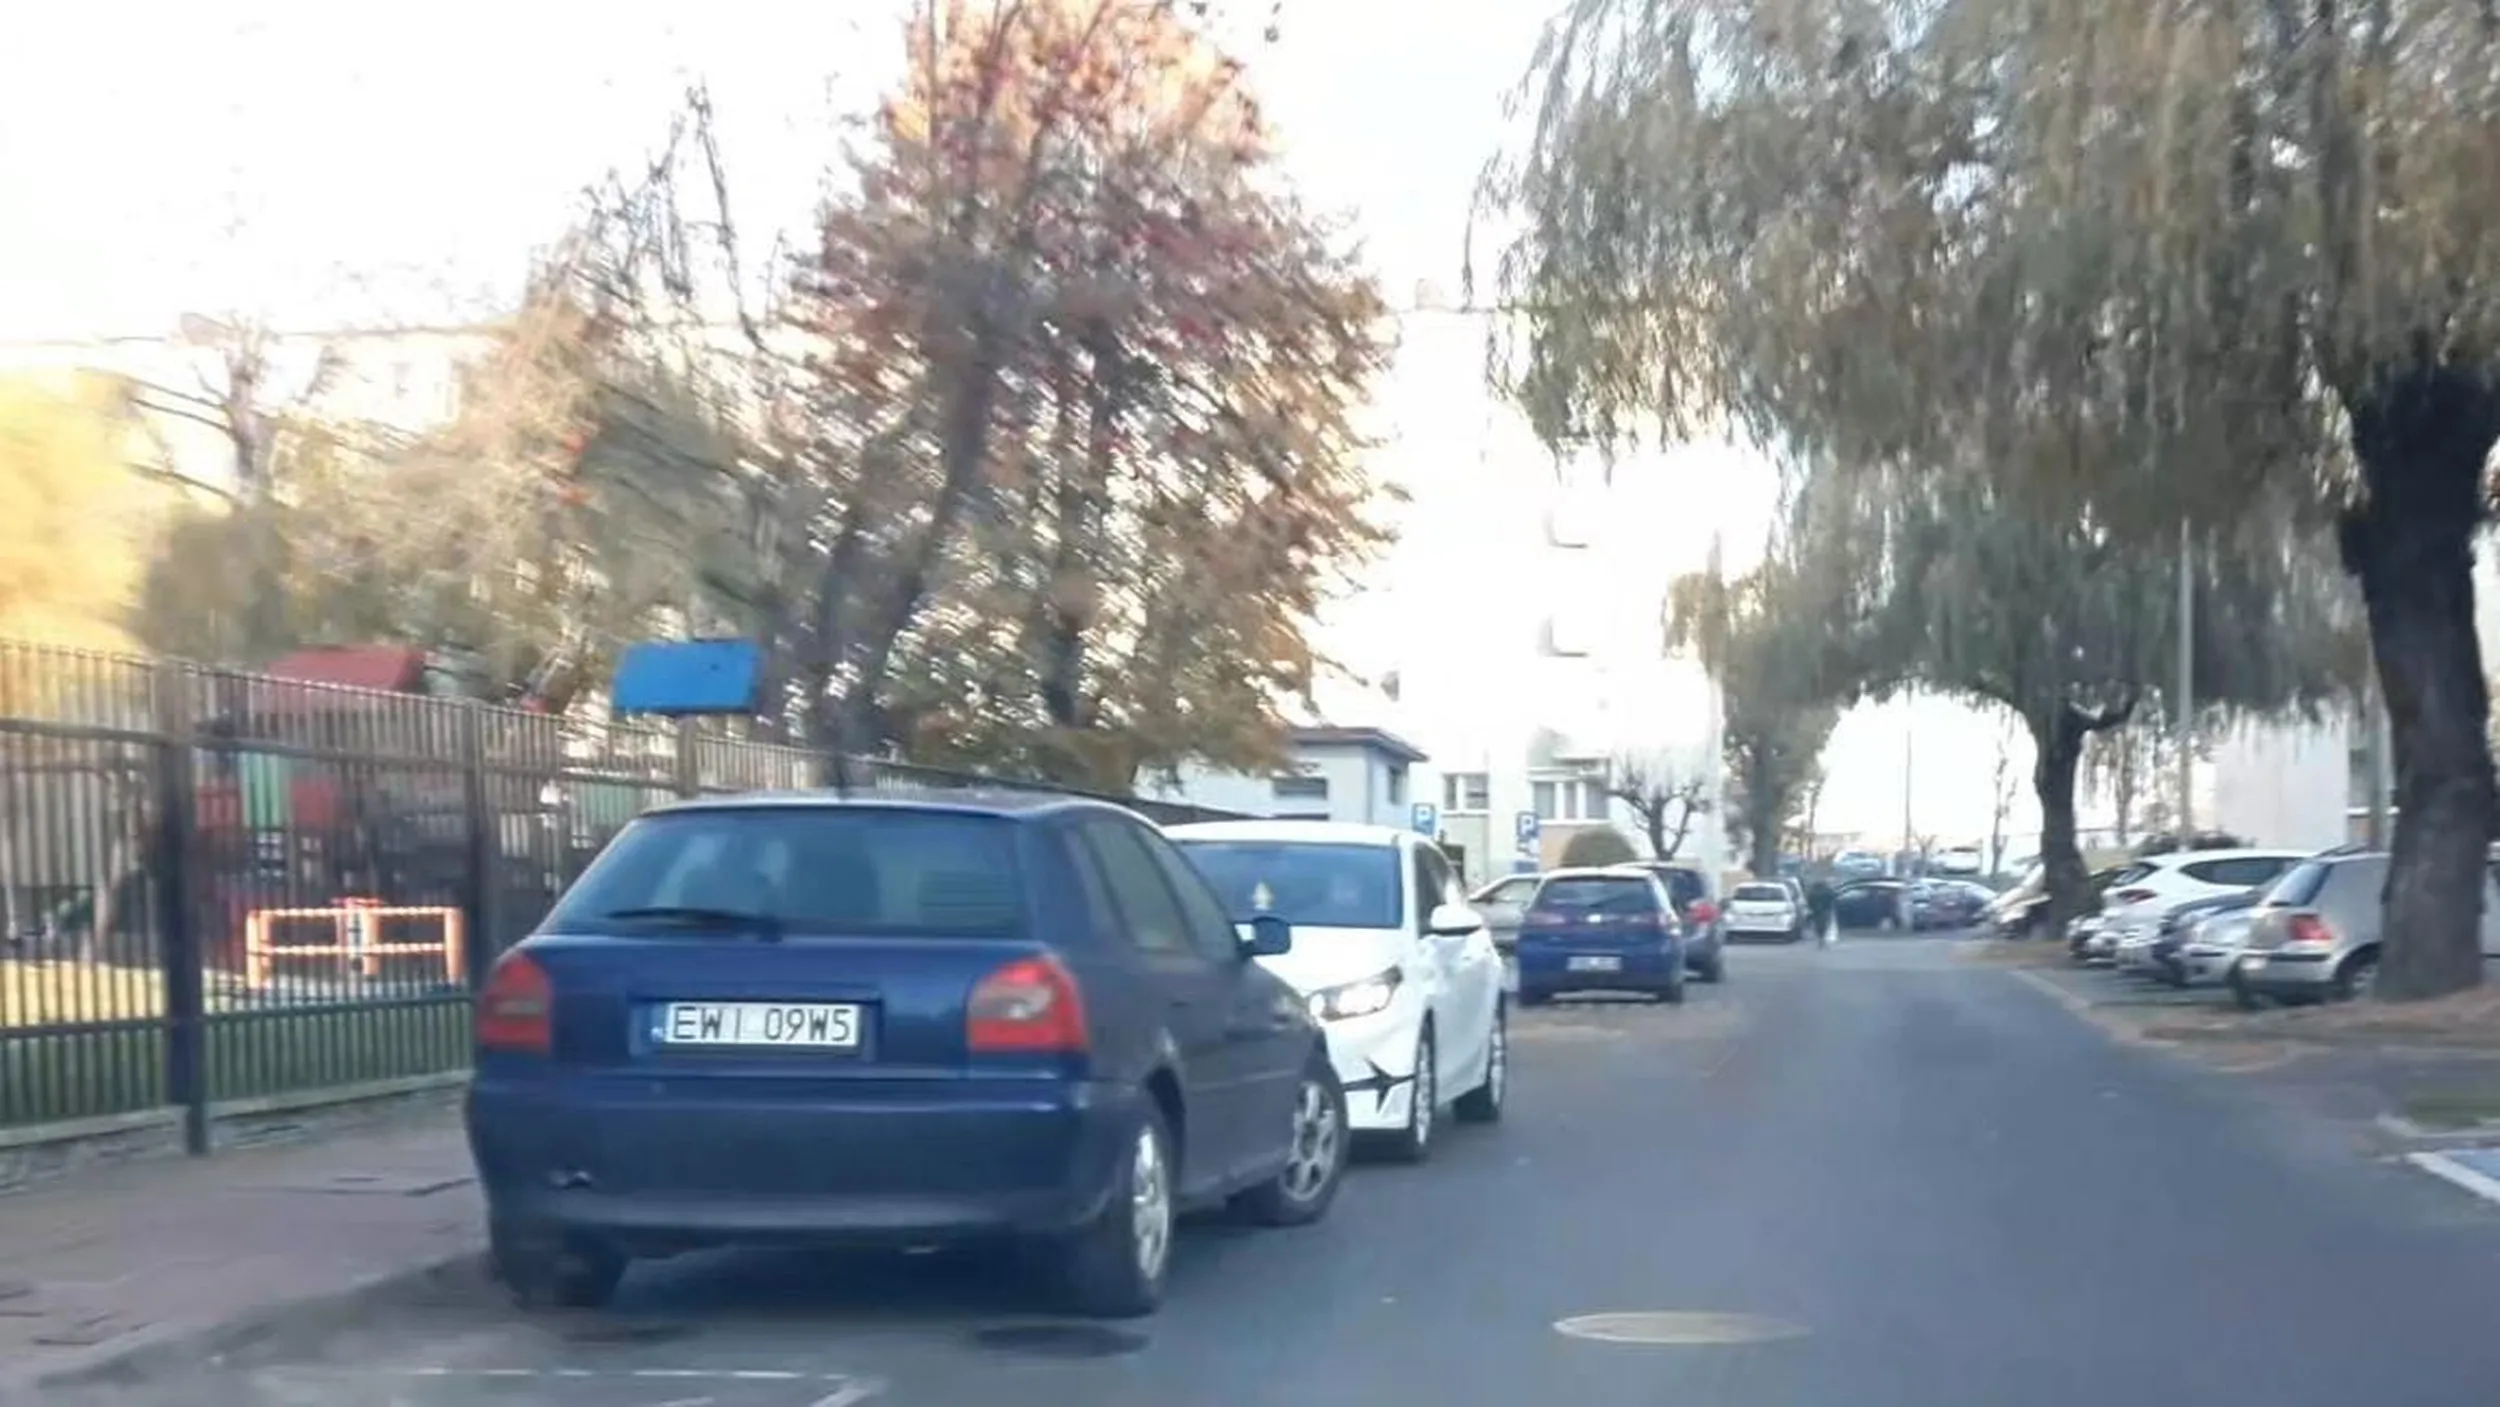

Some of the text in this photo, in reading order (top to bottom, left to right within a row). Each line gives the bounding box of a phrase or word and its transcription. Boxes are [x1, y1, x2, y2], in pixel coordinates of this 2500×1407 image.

[1520, 814, 1536, 837] P
[673, 1005, 852, 1043] EWI 09W5
